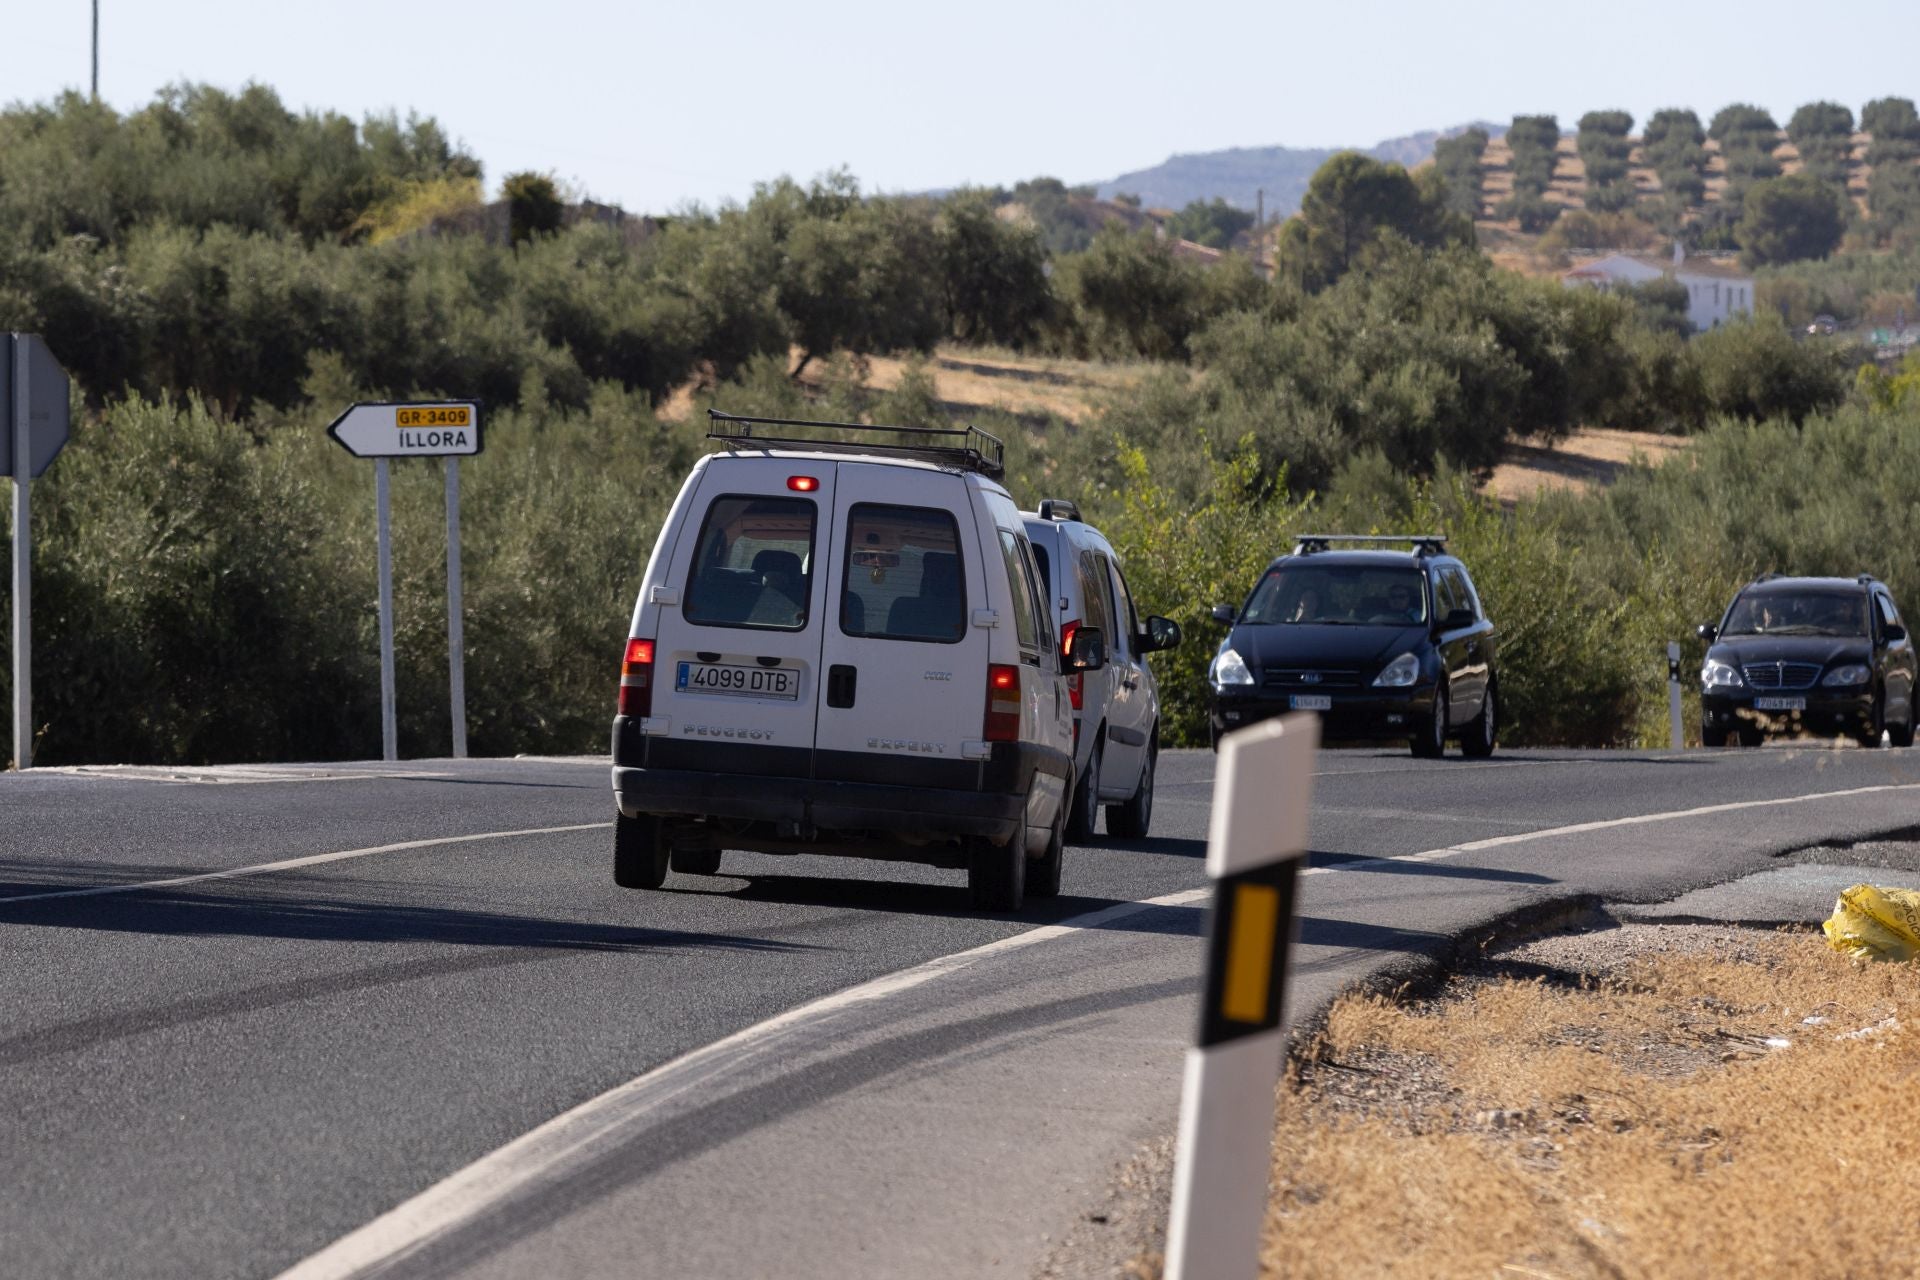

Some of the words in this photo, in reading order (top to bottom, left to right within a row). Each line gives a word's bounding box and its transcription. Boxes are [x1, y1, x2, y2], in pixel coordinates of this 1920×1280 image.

[399, 410, 467, 424] GR-3409
[399, 429, 467, 448] ÍLLORA
[693, 667, 745, 689] 4099
[750, 671, 788, 692] DTB
[683, 723, 776, 741] PEUGEOT
[866, 736, 945, 754] EXPERT
